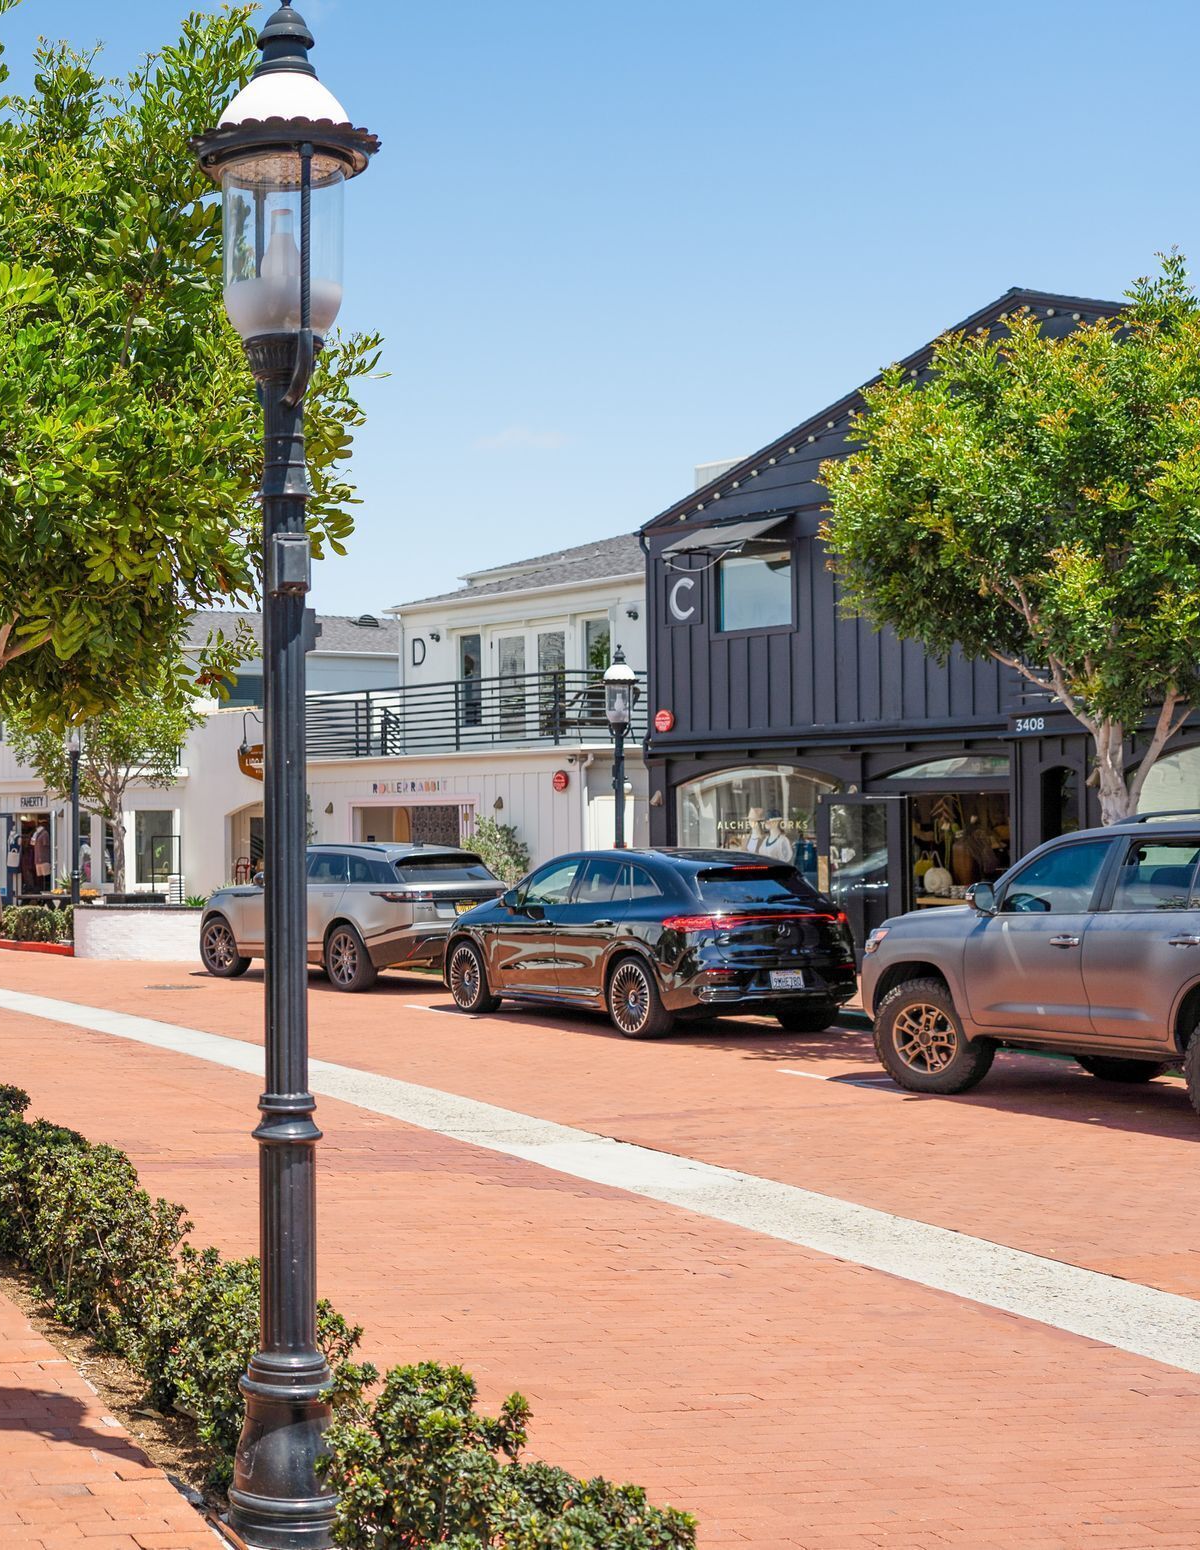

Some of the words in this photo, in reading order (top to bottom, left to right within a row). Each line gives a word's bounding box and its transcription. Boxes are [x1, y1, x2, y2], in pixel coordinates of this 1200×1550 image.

[669, 577, 695, 620] C
[412, 637, 426, 666] D
[1015, 717, 1045, 731] 3408
[20, 796, 44, 808] FAHERTY
